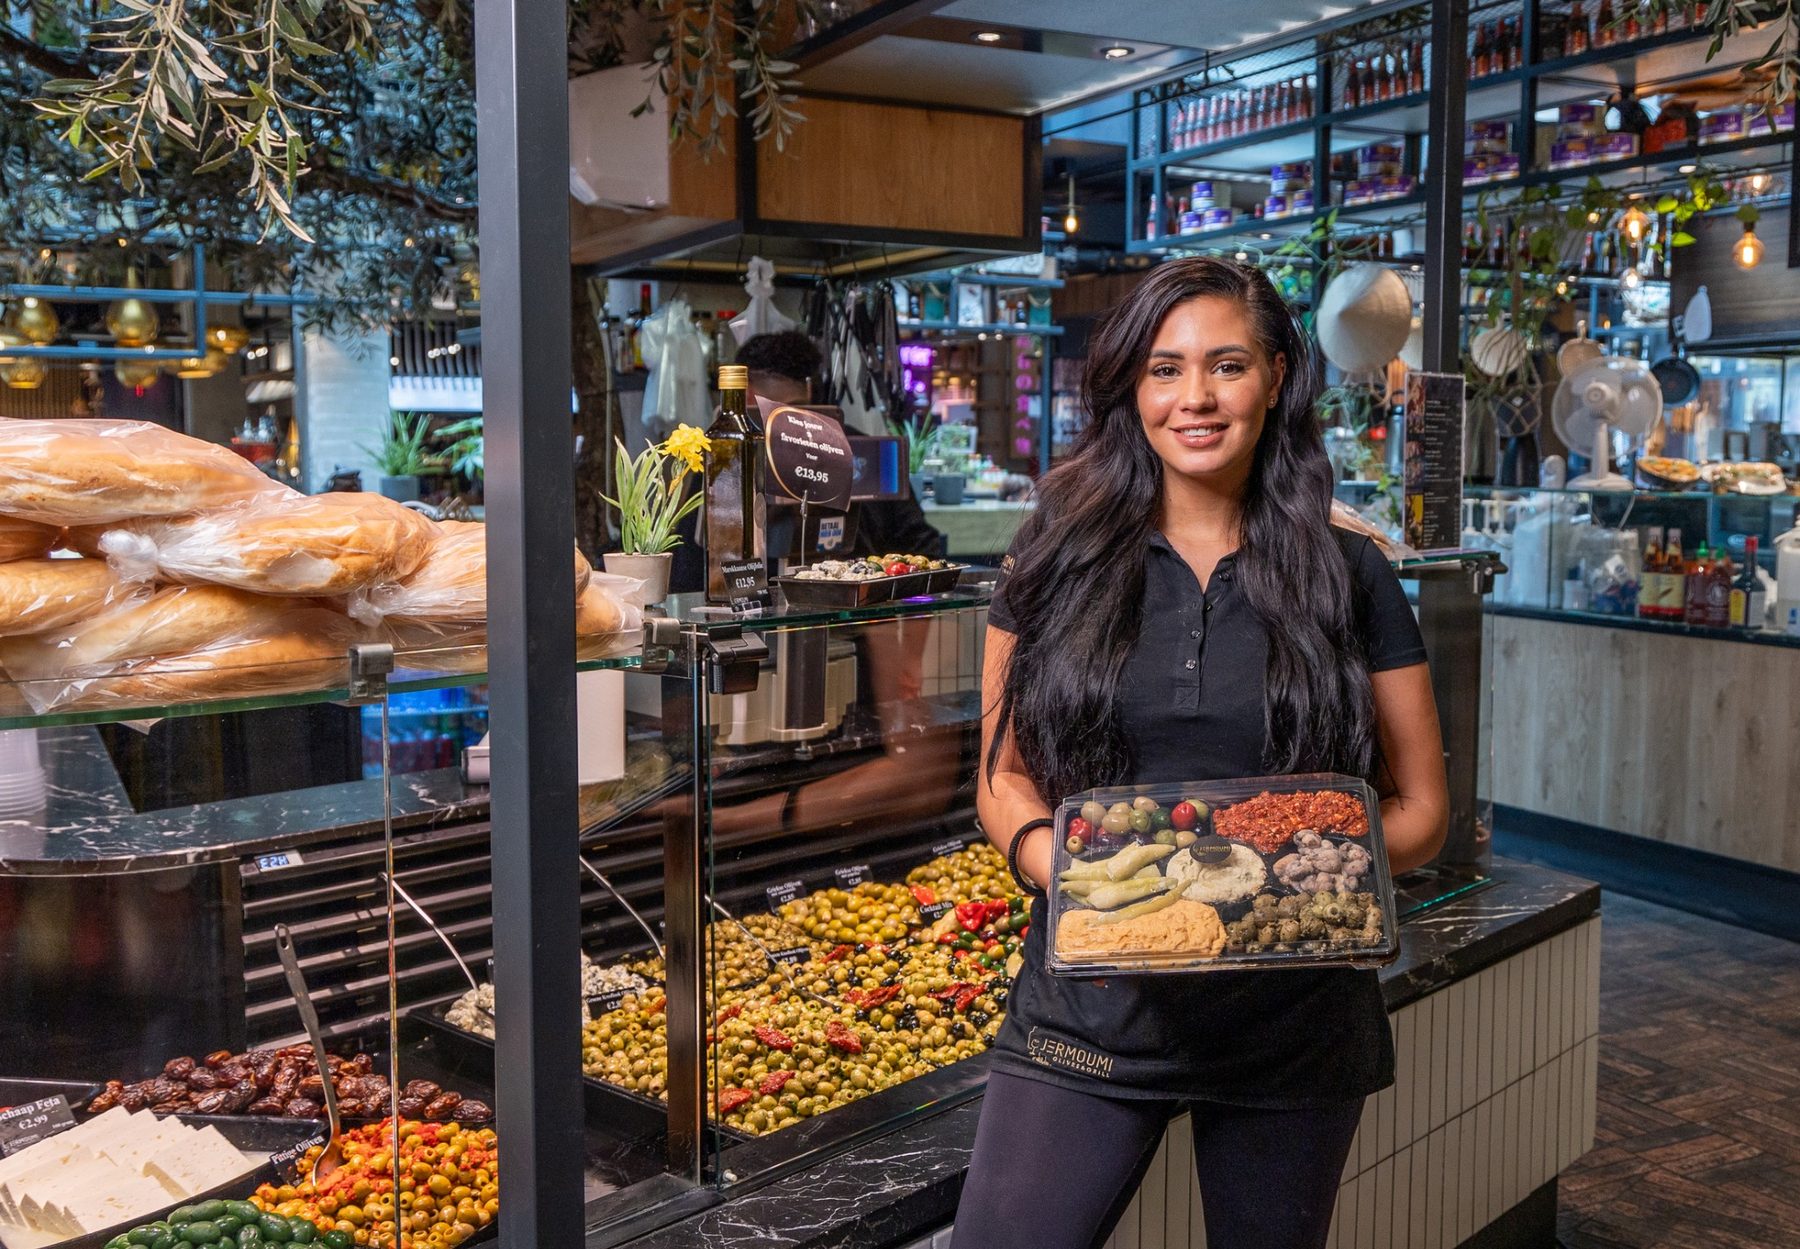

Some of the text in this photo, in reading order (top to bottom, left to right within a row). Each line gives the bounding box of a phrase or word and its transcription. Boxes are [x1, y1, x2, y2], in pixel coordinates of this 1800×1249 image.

[787, 415, 823, 430] Kies jouw
[780, 432, 844, 455] favorieten olijven
[795, 466, 829, 483] €13,95
[735, 576, 755, 588] €12,95
[920, 903, 942, 913] Cocktail
[0, 1097, 61, 1120] chaap Feta
[18, 1114, 48, 1130] €2,99
[271, 1135, 324, 1164] Pittige Olijven
